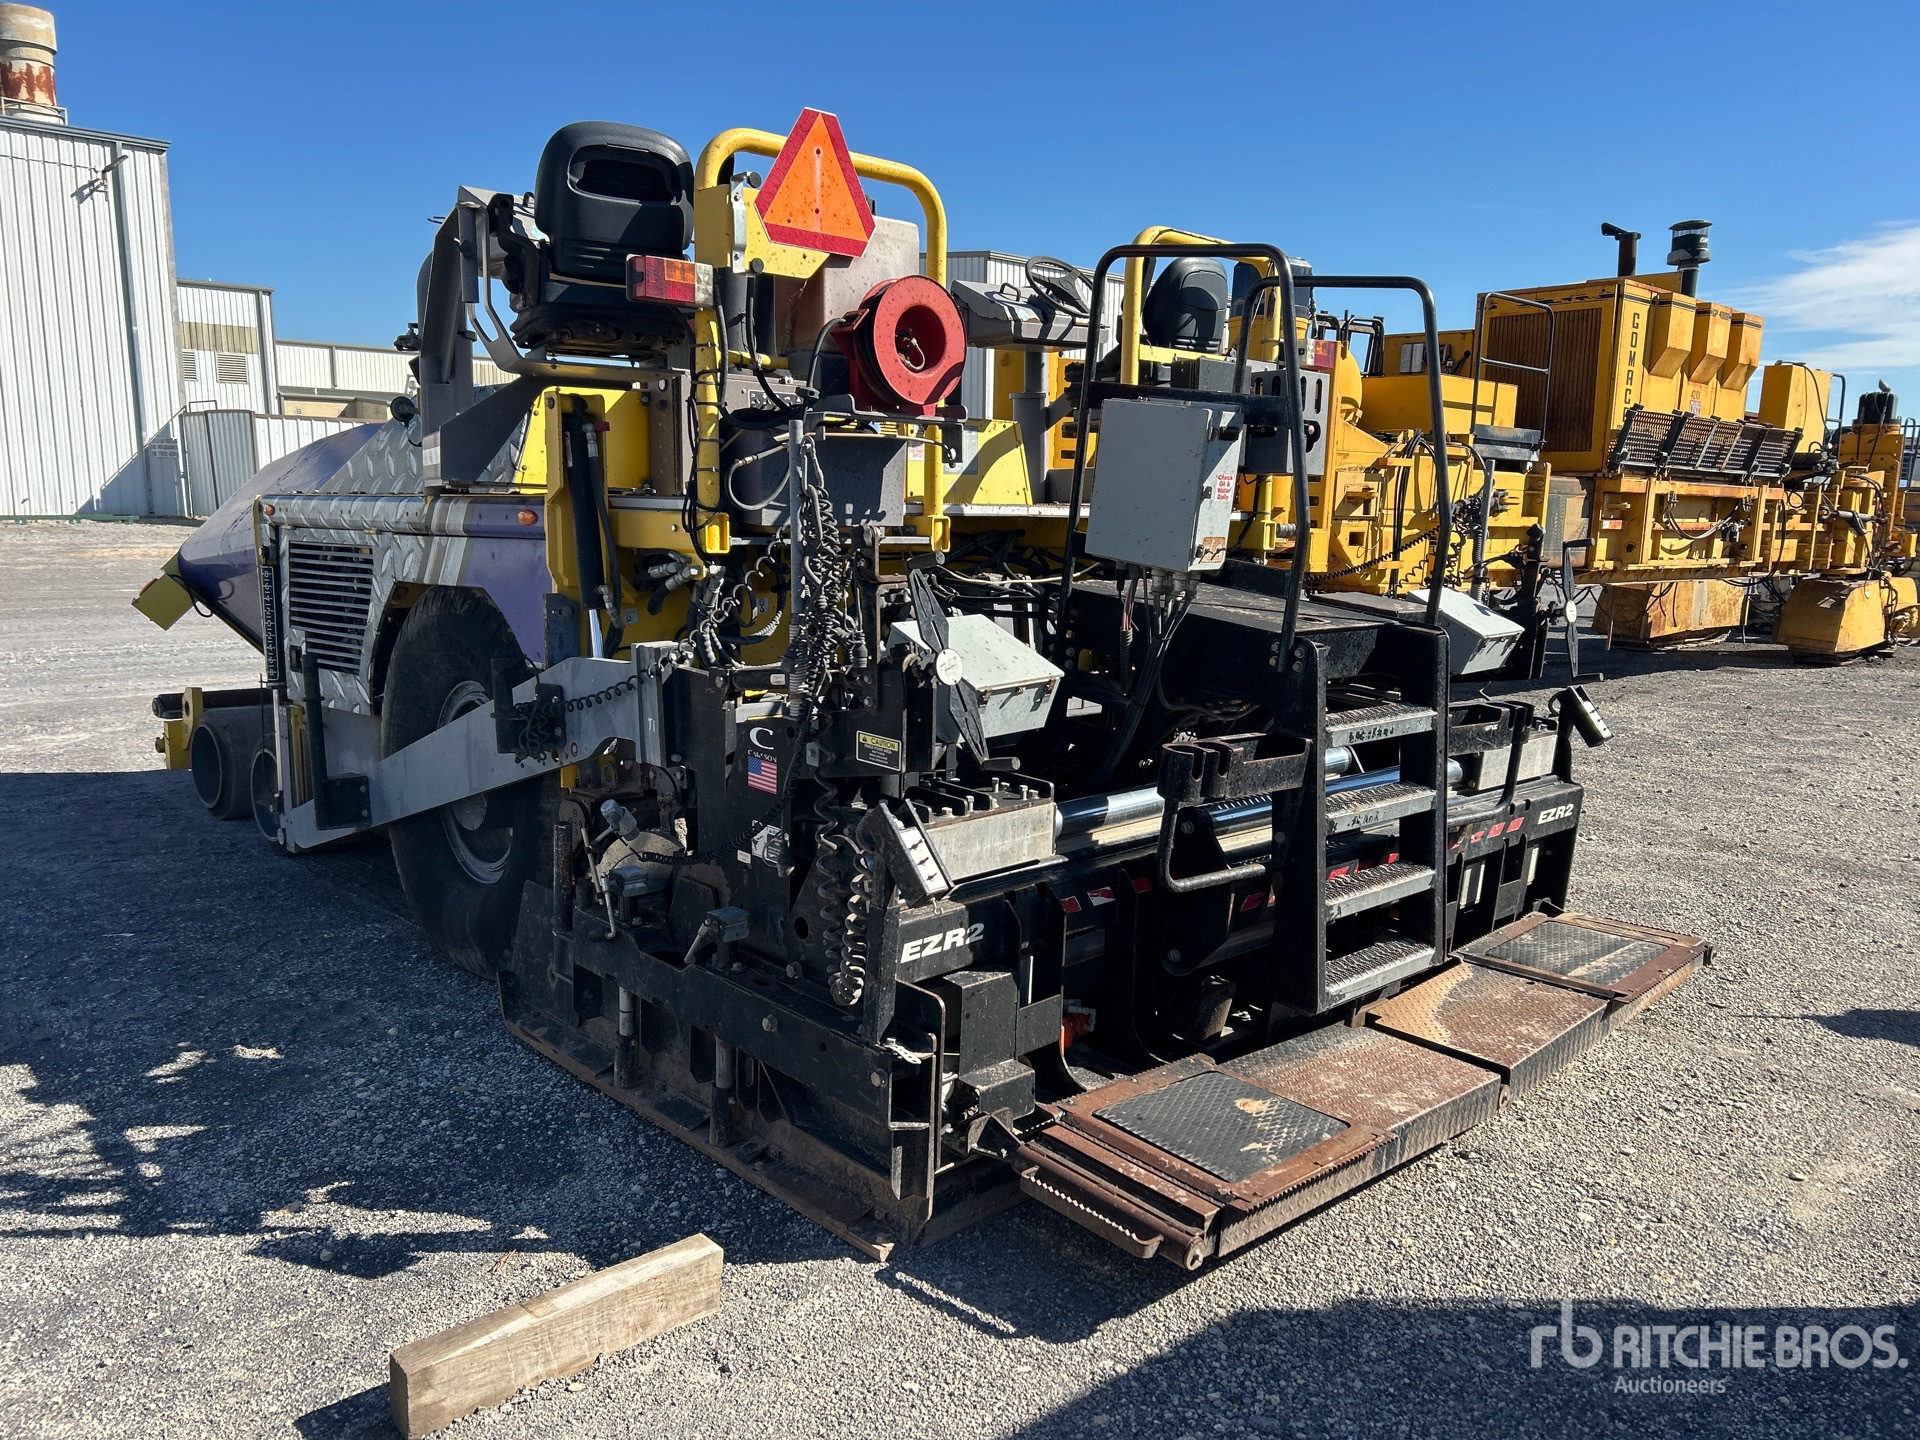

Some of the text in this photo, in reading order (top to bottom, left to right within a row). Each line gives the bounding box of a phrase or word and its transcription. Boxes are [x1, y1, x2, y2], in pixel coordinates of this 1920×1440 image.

[750, 727, 774, 749] C
[871, 737, 896, 749] CAUTION
[1538, 803, 1574, 825] EZR2
[900, 922, 985, 964] EZR2
